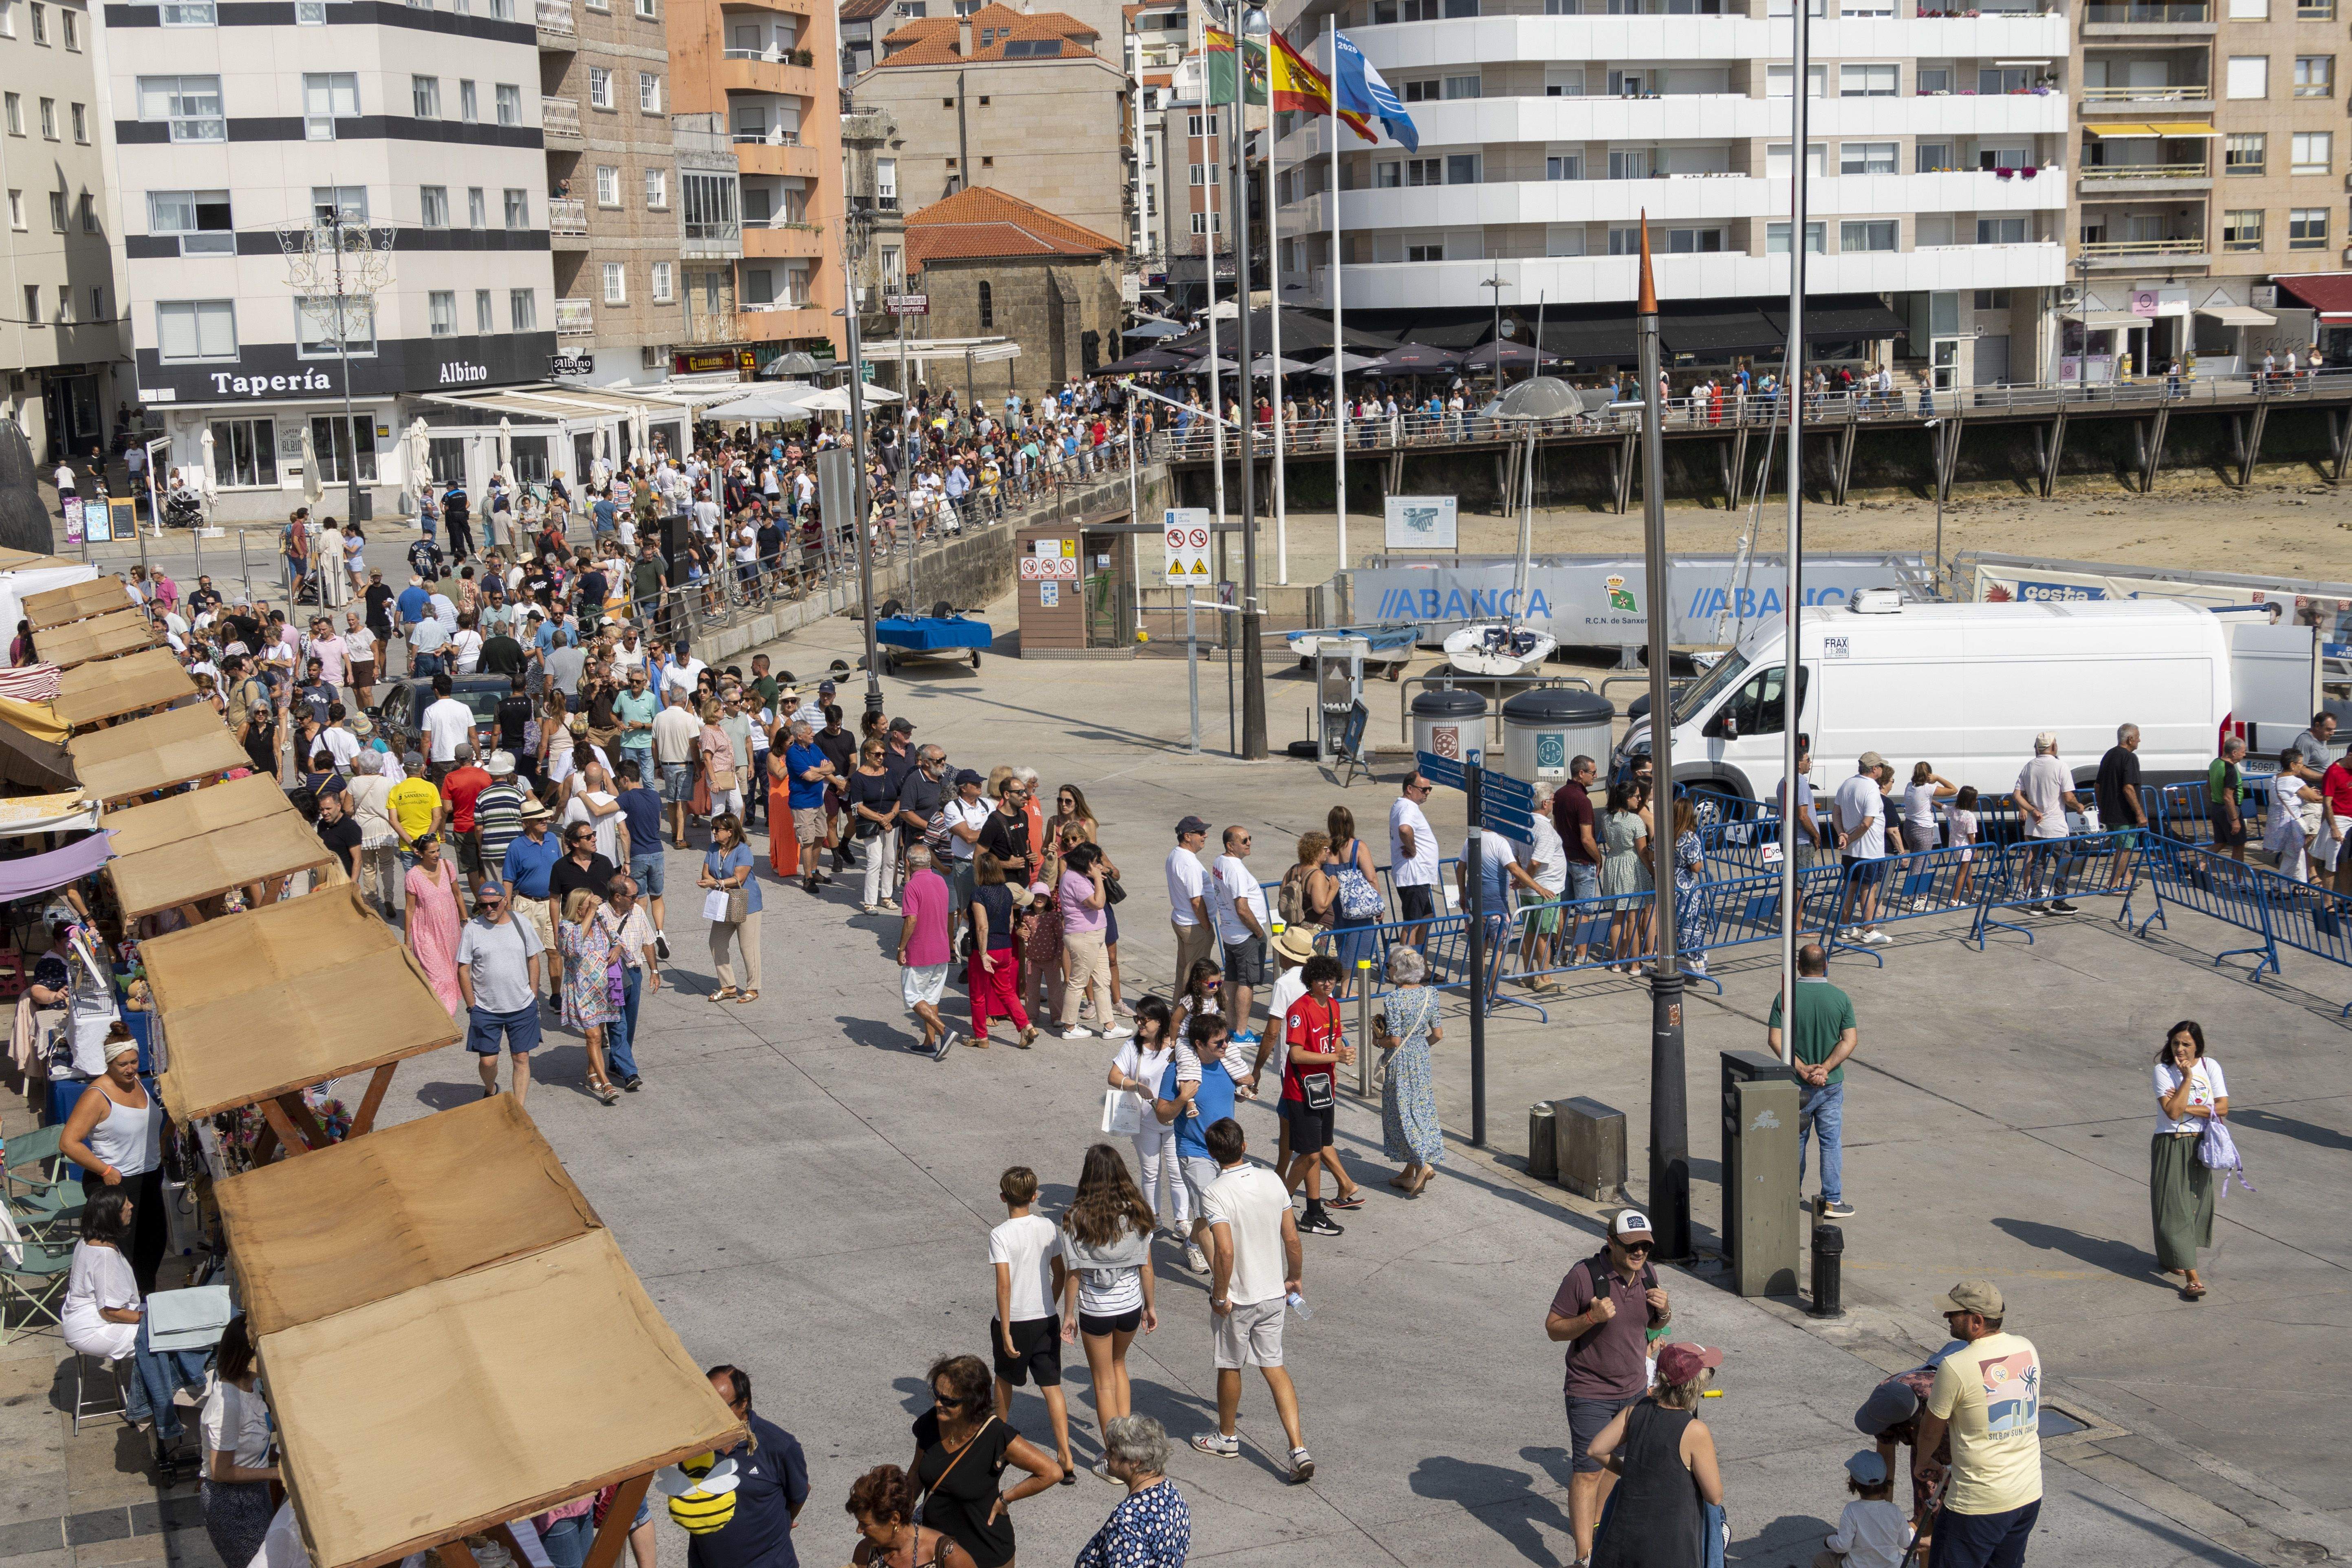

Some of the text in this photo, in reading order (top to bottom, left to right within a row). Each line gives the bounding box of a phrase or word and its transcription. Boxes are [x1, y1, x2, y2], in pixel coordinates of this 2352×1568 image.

[698, 357, 723, 366] TABACOS
[440, 361, 487, 383] Albino
[211, 368, 331, 396] Tapería
[282, 440, 302, 452] ALBIN
[1826, 639, 1848, 648] FRAX
[1438, 759, 1460, 771] Centro urbano
[2252, 762, 2275, 771] 5060
[1437, 773, 1460, 786] Paseo marítimo
[1487, 774, 1523, 791] Oficina información
[1495, 792, 1507, 801] Náutico
[1487, 805, 1501, 814] Mirador
[1989, 1431, 2009, 1440] SILBON
